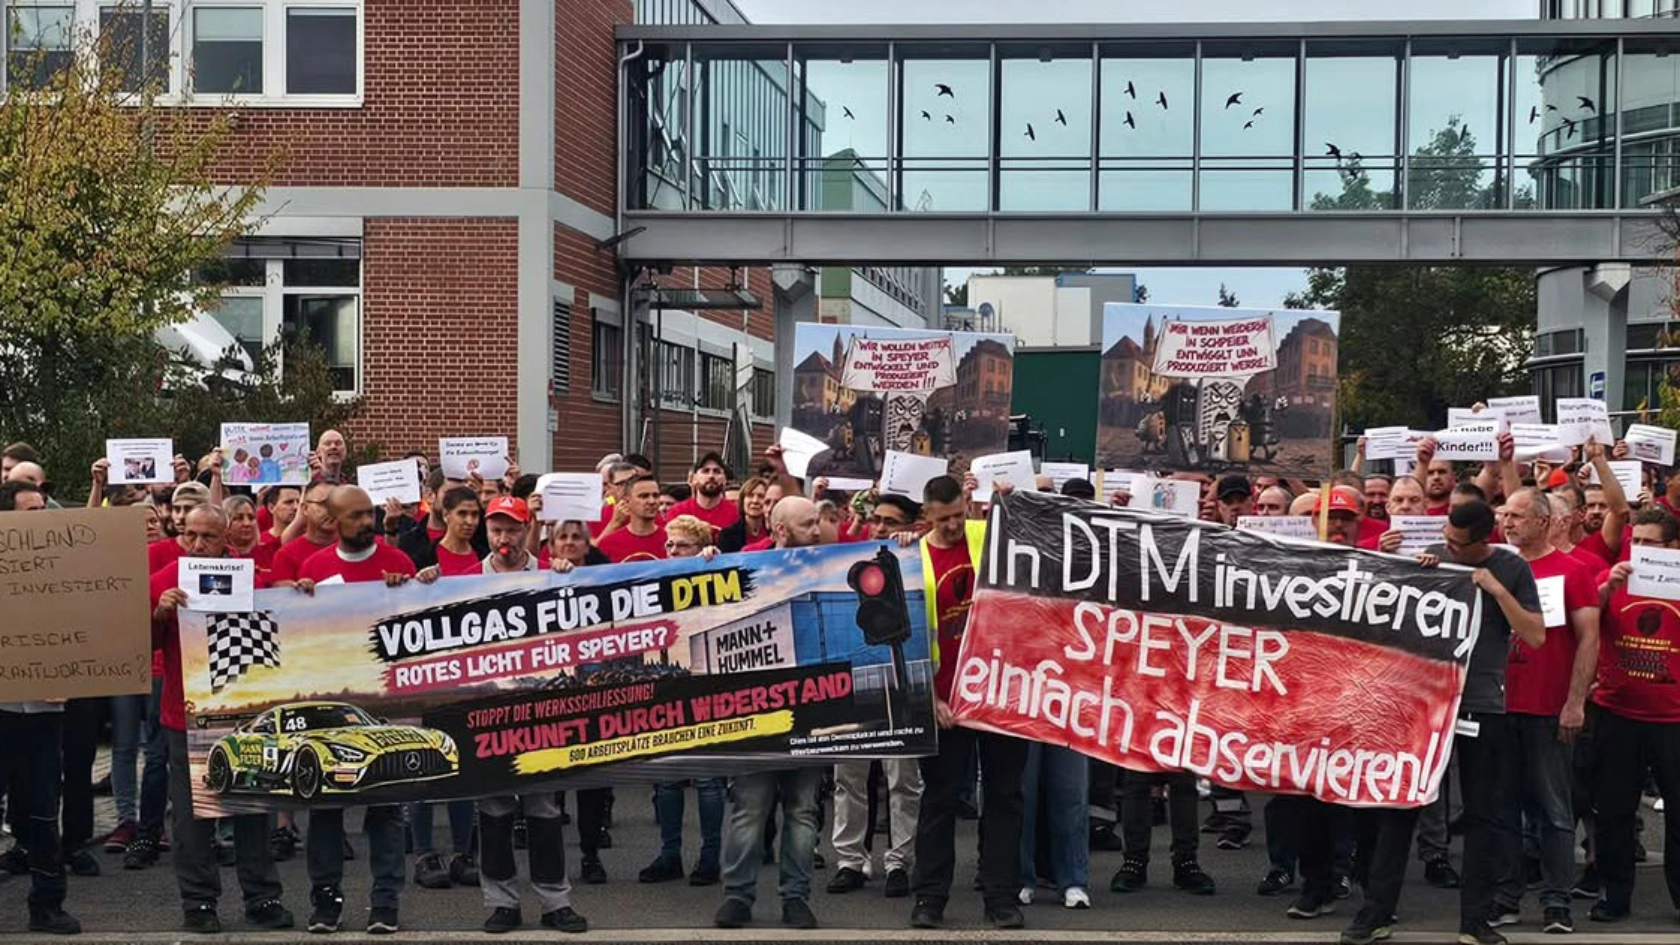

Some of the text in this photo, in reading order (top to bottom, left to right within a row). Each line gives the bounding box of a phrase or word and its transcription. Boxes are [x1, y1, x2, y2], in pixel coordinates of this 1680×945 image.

[1192, 326, 1219, 335] WENN
[887, 352, 929, 362] SPEYER
[916, 361, 940, 371] UND
[1436, 441, 1493, 452] Kinder!!!
[988, 504, 1040, 589] In
[1063, 512, 1201, 603] DTM
[7, 577, 132, 595] INVESTIERT
[378, 570, 741, 656] VOLLGAS FÜR DIE DTM
[716, 621, 777, 654] MANN+
[1064, 601, 1290, 696] SPEYER
[396, 626, 668, 687] ROTES LICHT FÜR SPEYER?
[718, 643, 784, 674] HUMMEL
[467, 683, 655, 729] STOPPT DIE WERKSSCHLIESSUNG!
[475, 671, 853, 759] ZUKUNFT DURCH WIDERSTAND
[286, 716, 307, 731] 48
[652, 729, 697, 747] BRAUCHEN
[698, 725, 717, 740] EINE
[717, 718, 757, 737] ZUKUNFT.
[959, 648, 1439, 803] einfach abservieren!
